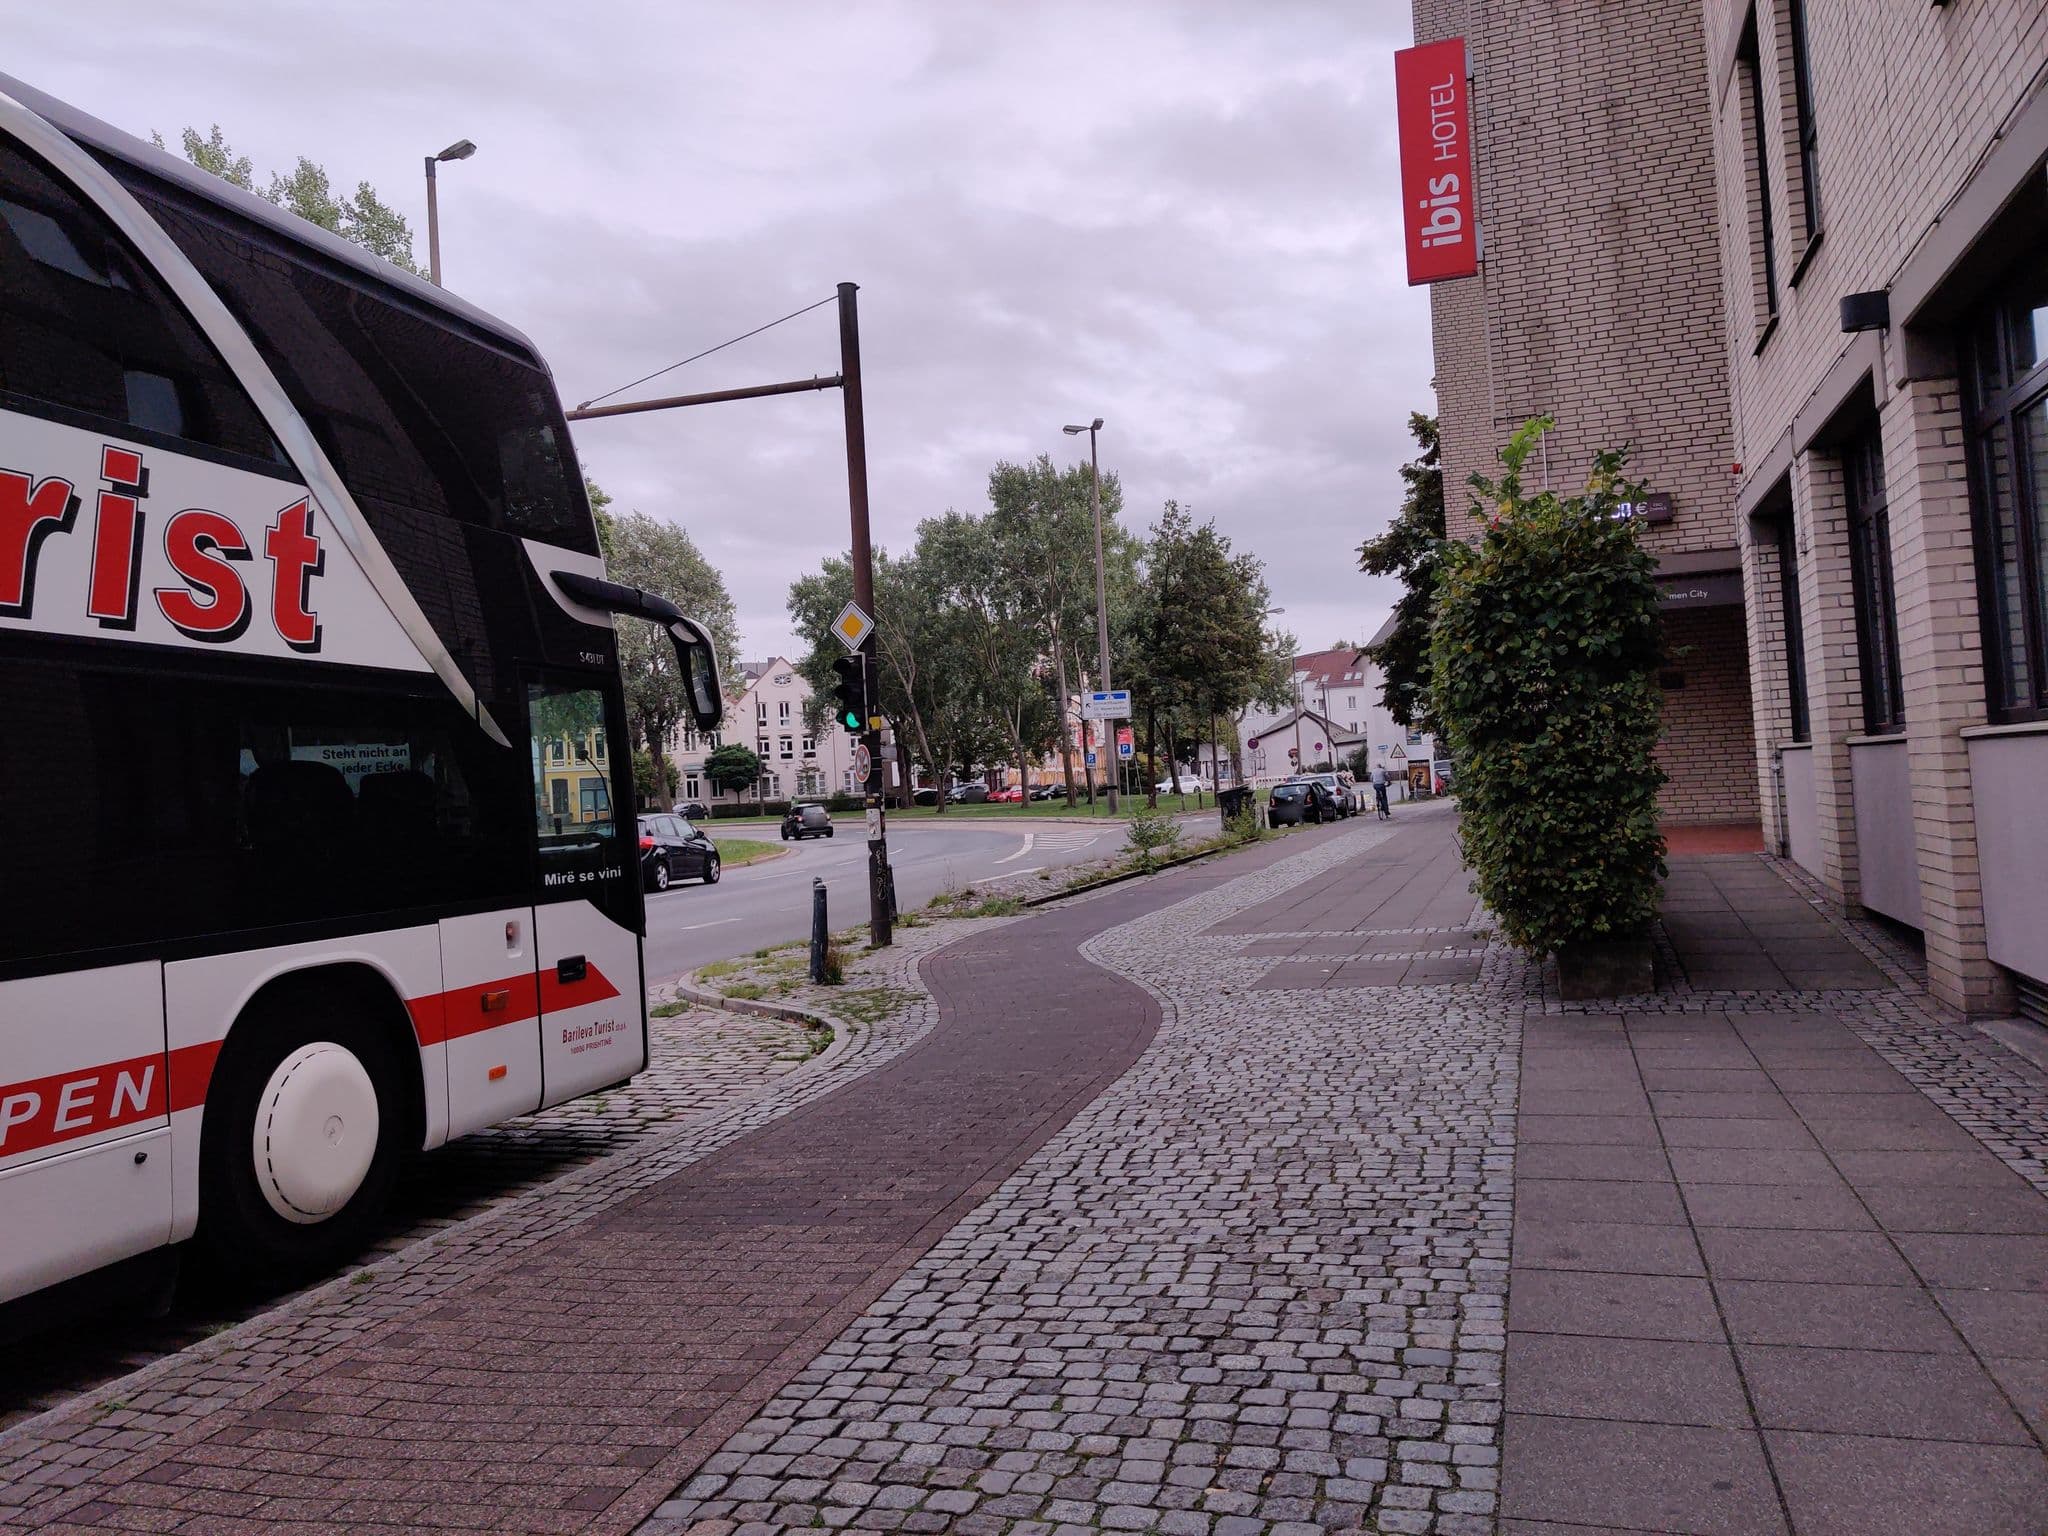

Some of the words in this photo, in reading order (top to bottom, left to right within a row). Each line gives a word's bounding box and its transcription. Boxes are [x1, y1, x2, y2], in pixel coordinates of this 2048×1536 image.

[1430, 73, 1458, 161] HOTEL
[1419, 173, 1463, 248] ibis
[1689, 589, 1708, 599] City
[322, 748, 356, 760] Steht
[359, 747, 390, 758] nicht
[392, 748, 407, 757] an
[342, 762, 373, 775] jeder
[544, 870, 575, 886] Mirë
[579, 871, 595, 882] se
[598, 865, 622, 879] vini
[562, 1025, 593, 1044] Barileva
[594, 1018, 615, 1036] Turist
[0, 1065, 155, 1147] PEN
